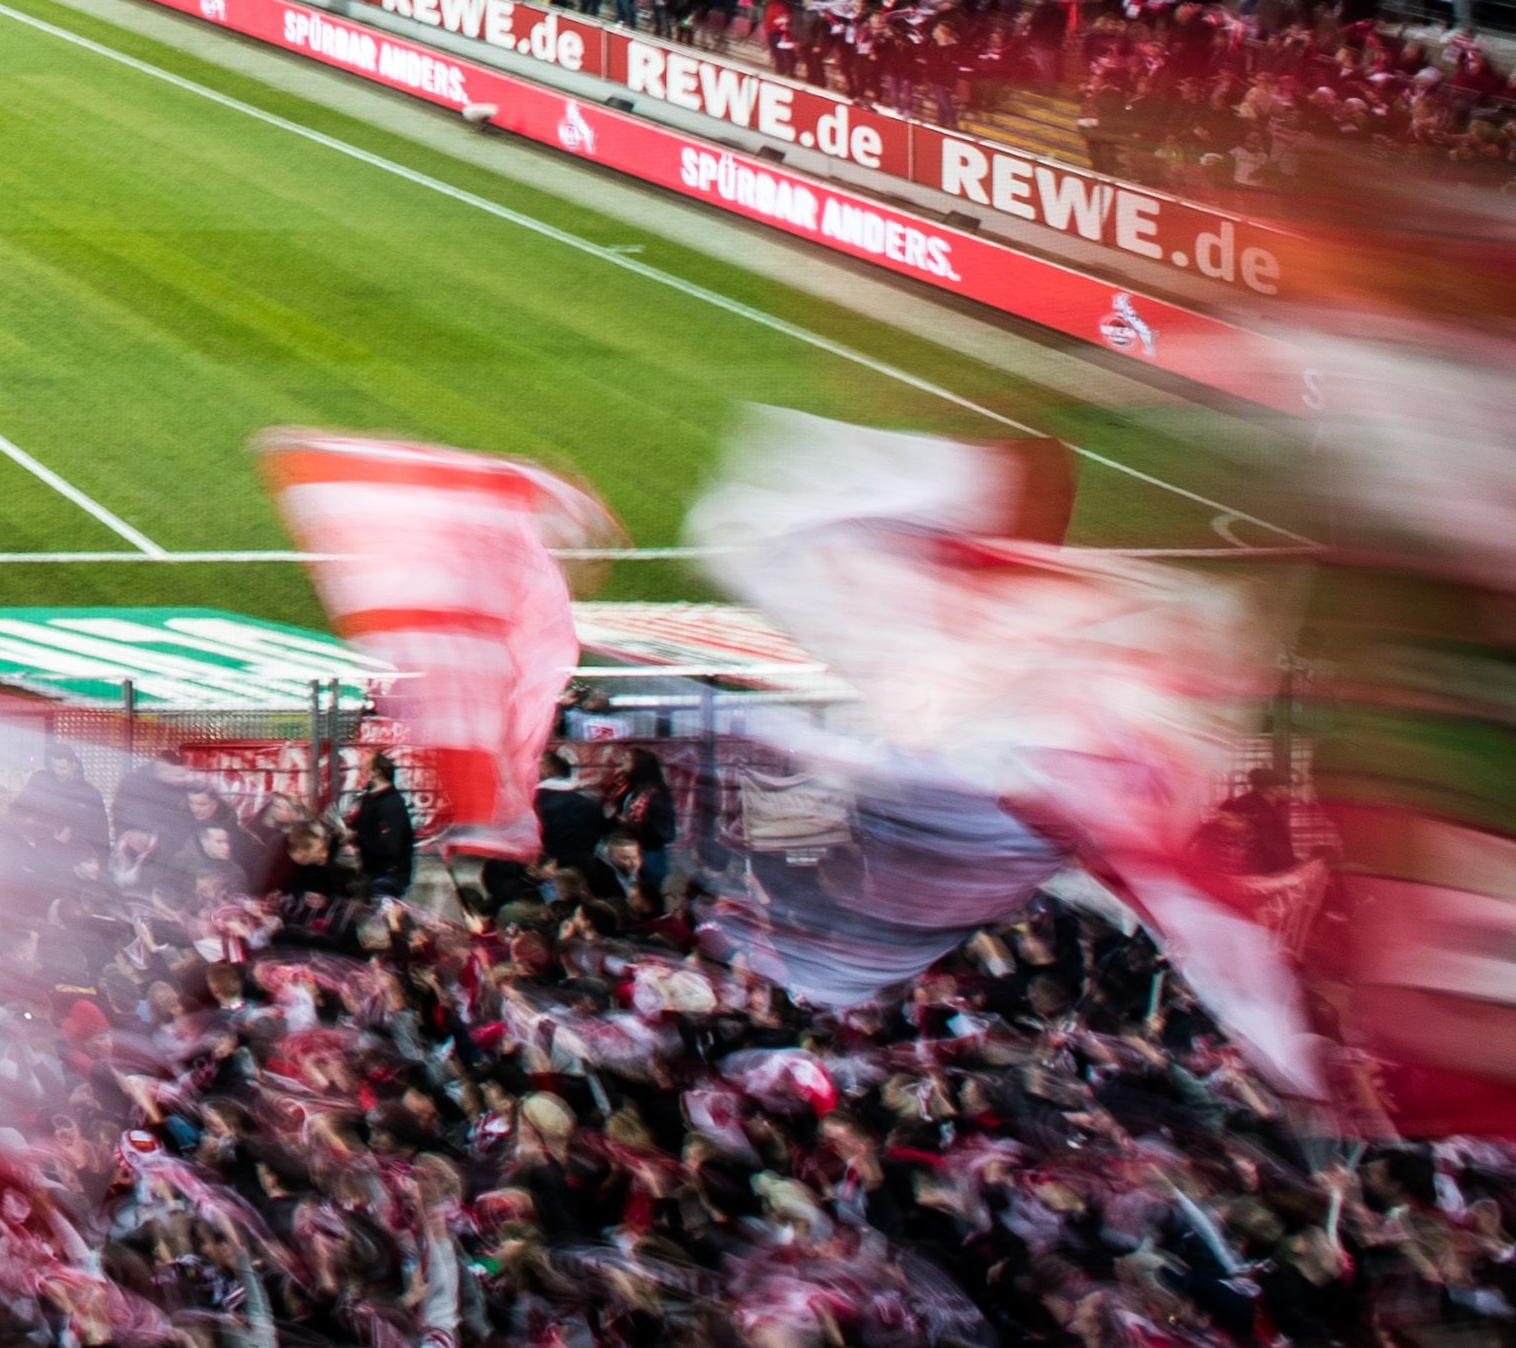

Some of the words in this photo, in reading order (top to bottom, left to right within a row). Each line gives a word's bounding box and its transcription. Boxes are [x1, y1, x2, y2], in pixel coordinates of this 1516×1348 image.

[283, 9, 379, 81] SPÜRBAR
[379, 40, 469, 104] ANDERS.
[627, 38, 884, 170] REWE.de
[680, 146, 818, 233] SPÜRBAR
[821, 192, 962, 283] ANDERS.
[941, 138, 1281, 296] REWE.de
